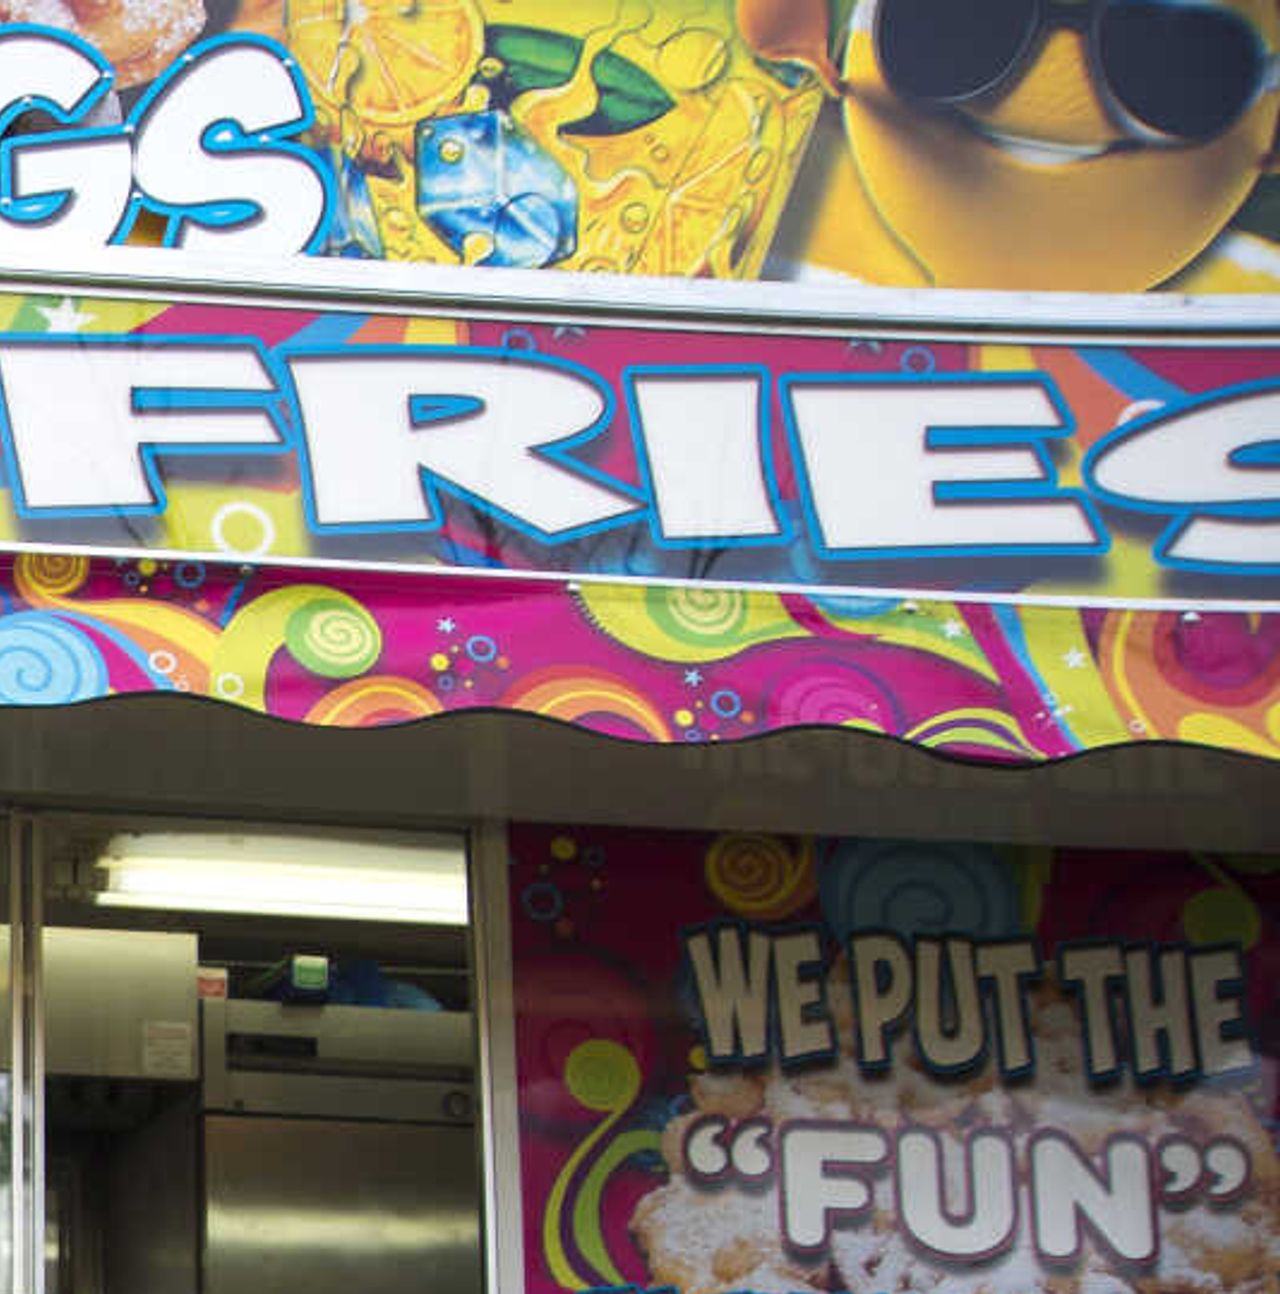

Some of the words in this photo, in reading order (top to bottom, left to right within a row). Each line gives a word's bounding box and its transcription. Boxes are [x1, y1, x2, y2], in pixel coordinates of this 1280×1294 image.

[683, 925, 835, 1068] WE
[851, 931, 1038, 1075] PUT
[1060, 942, 1253, 1080] THE
